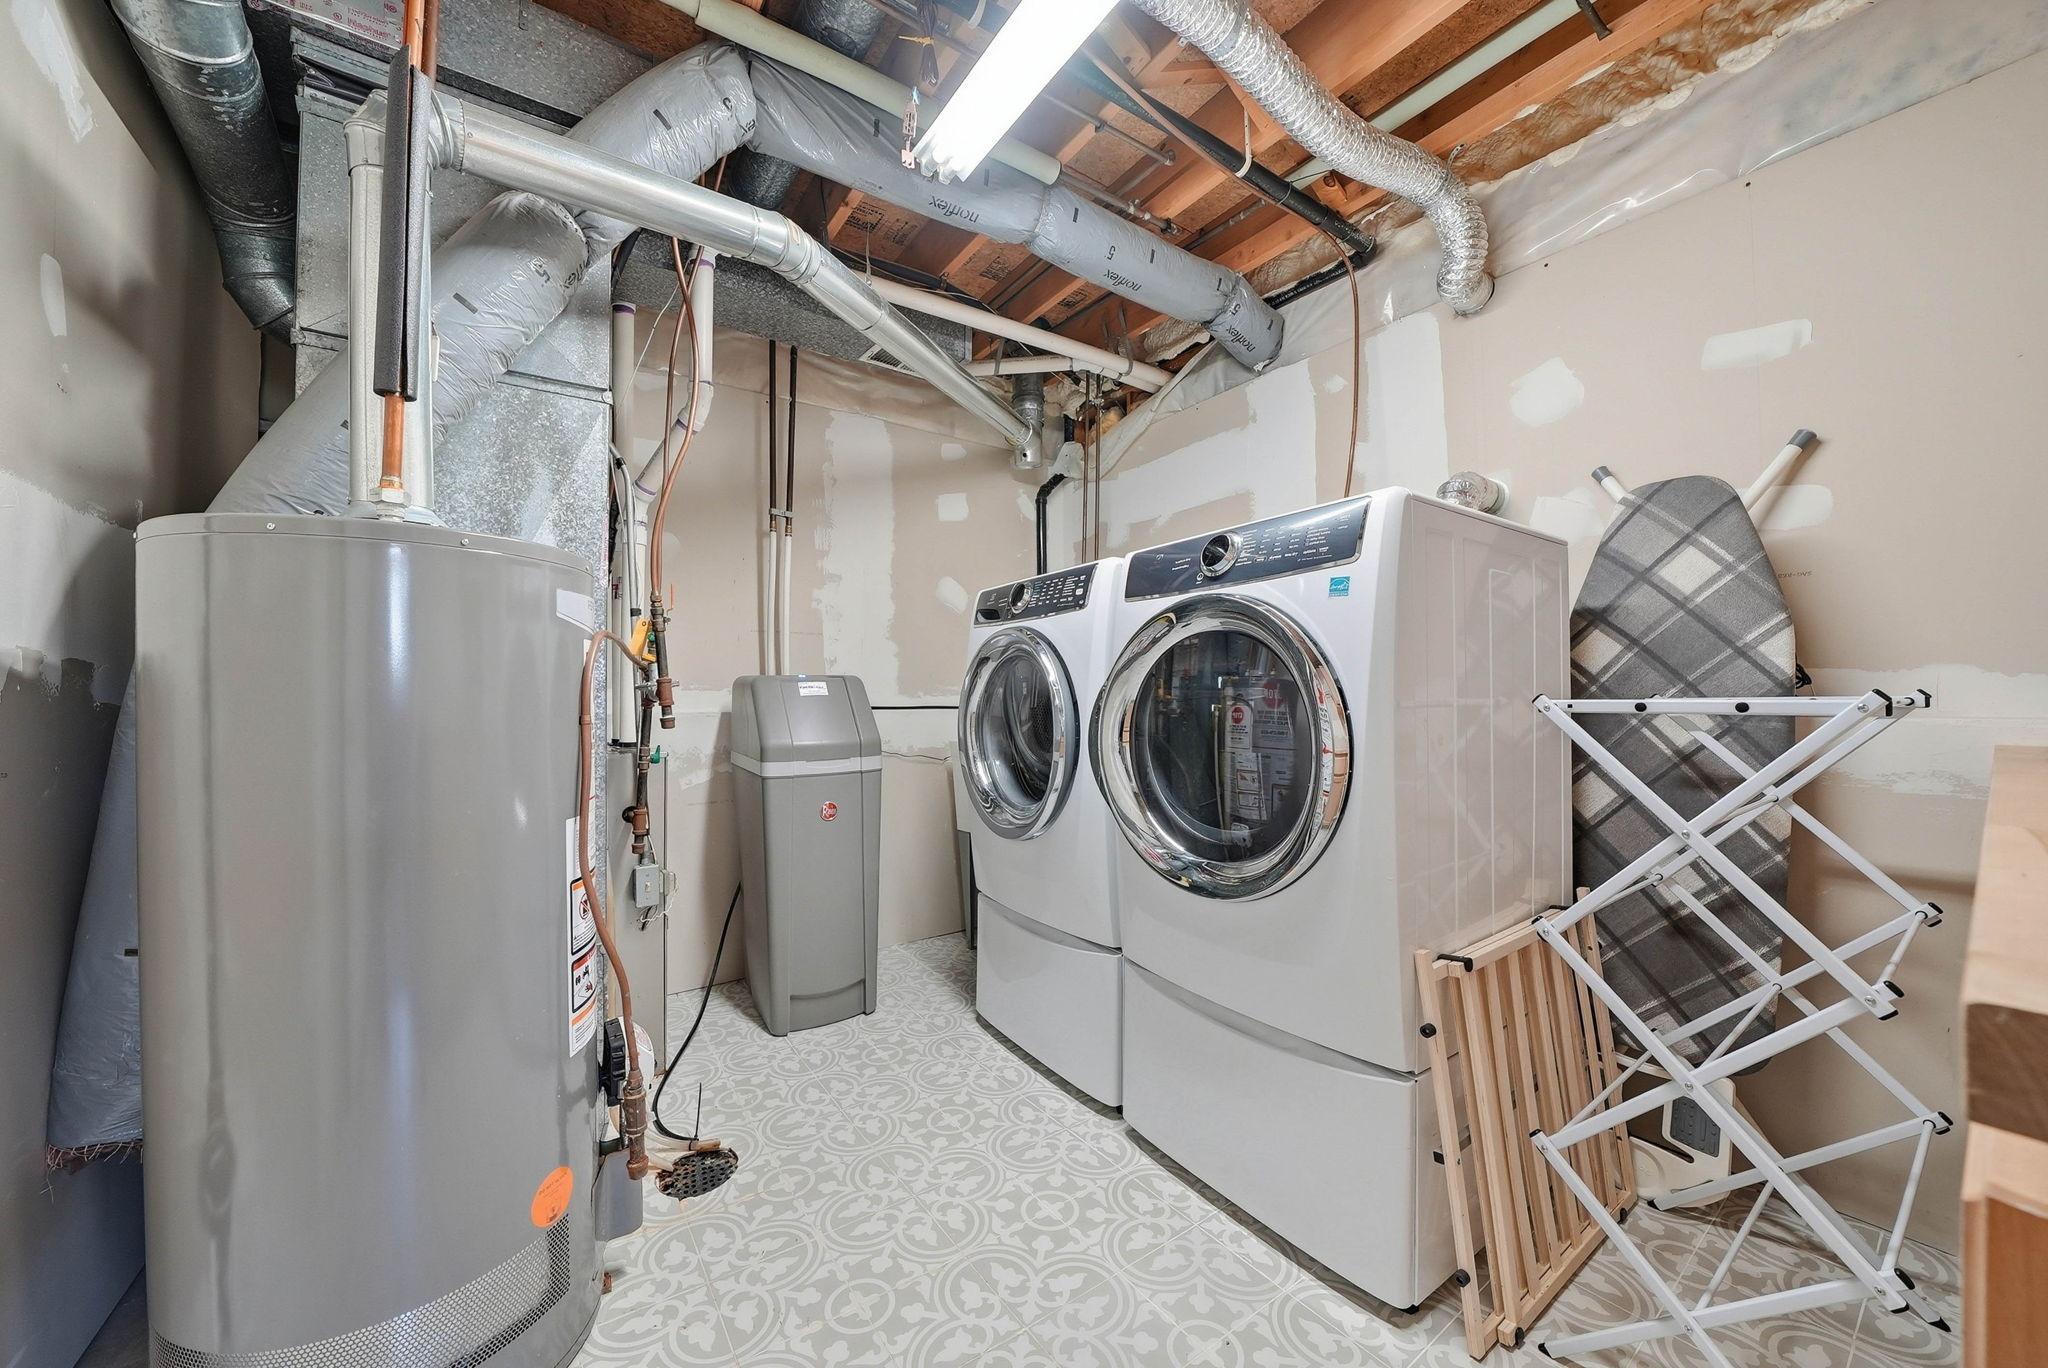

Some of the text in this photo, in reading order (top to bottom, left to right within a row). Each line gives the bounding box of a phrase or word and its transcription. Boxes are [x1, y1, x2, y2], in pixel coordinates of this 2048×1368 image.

[928, 195, 980, 223] norflex
[1103, 269, 1143, 292] norflex
[1225, 324, 1257, 353] norflex
